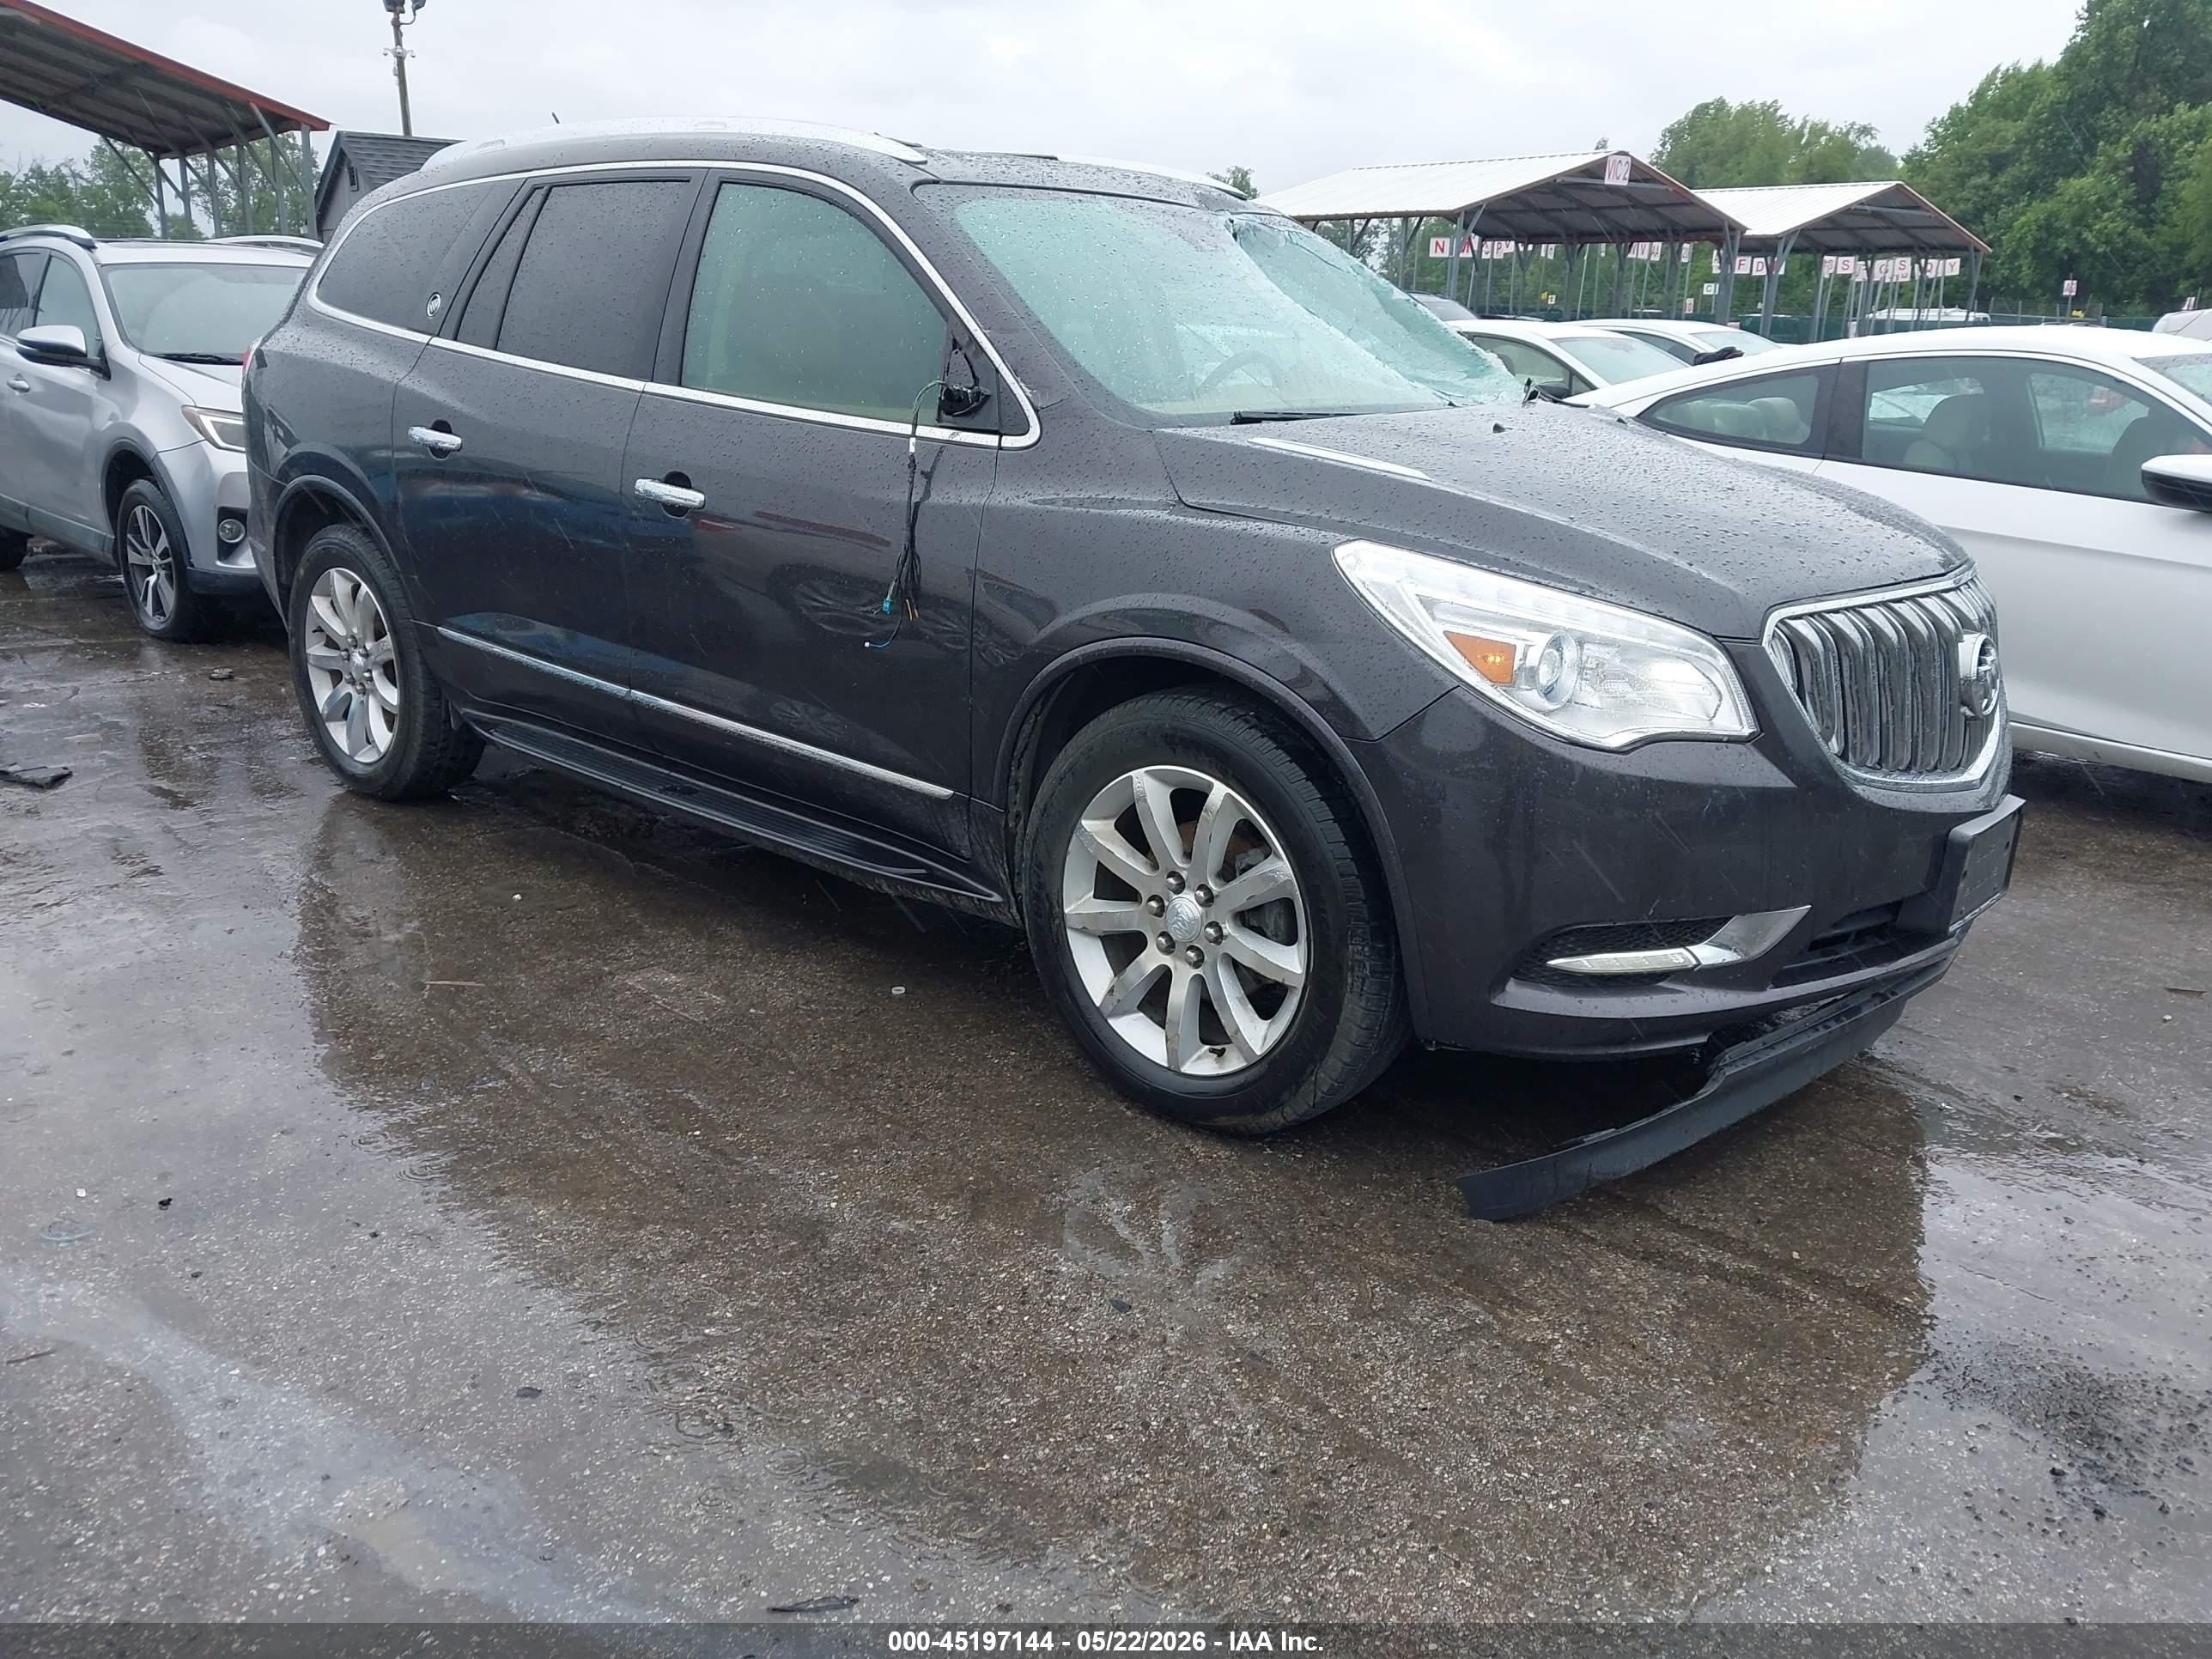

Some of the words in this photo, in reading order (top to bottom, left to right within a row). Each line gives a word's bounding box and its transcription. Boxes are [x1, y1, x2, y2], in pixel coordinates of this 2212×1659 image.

[1607, 159, 1622, 180] VIC
[1622, 160, 1630, 181] 2
[1434, 240, 1445, 253] N
[1737, 258, 1747, 270] F
[1755, 260, 1765, 272] D
[1841, 259, 1850, 270] S
[1898, 259, 1907, 271] S
[1948, 261, 1957, 272] Y
